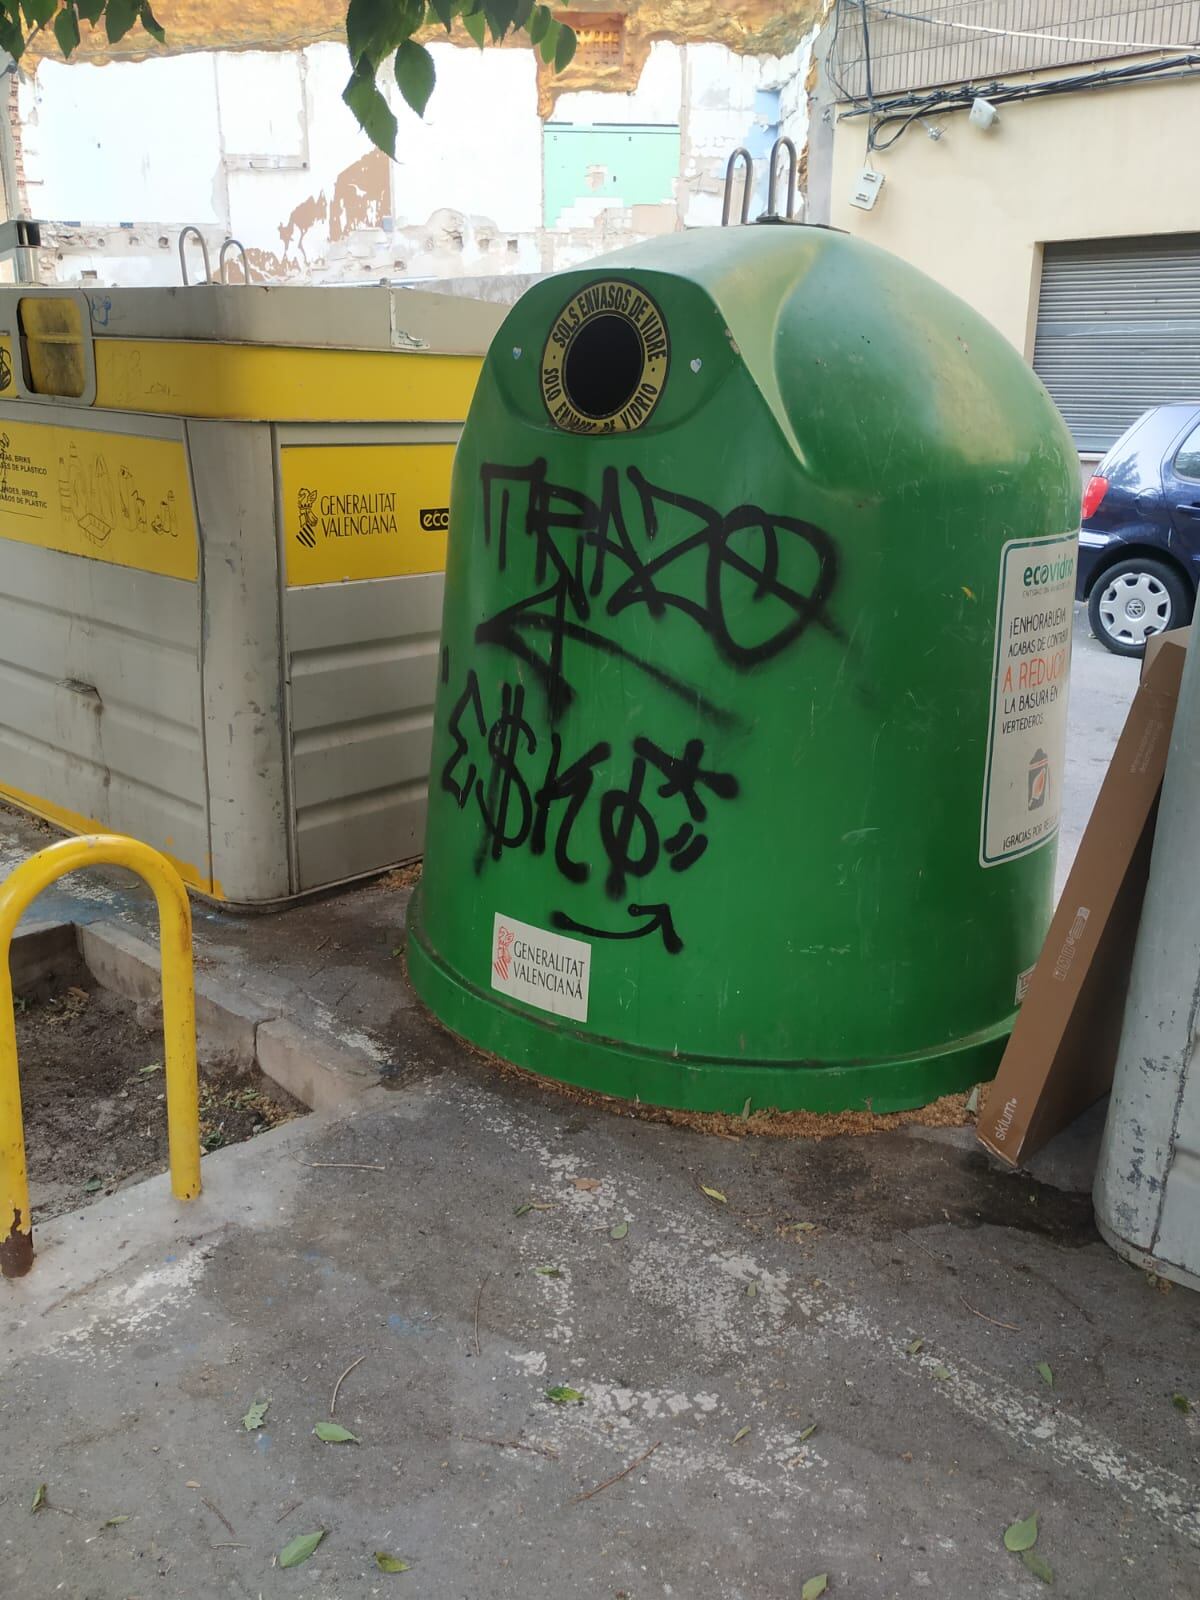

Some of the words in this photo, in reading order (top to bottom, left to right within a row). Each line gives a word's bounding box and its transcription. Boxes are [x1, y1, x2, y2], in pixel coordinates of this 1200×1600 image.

[552, 308, 581, 348] SOLS
[577, 284, 632, 316] ENVASOS
[628, 296, 649, 323] DE
[639, 312, 667, 363] VIDRE
[544, 368, 562, 402] SOLO
[620, 383, 657, 431] VIDRIO
[320, 492, 397, 517] GENERALITAT
[321, 514, 398, 539] VALENCIANA
[1008, 639, 1036, 658] ACABAS
[1037, 637, 1046, 652] DE
[1003, 665, 1013, 693] A
[1004, 697, 1016, 714] LA
[1018, 688, 1049, 712] BASURA
[1050, 686, 1059, 702] EN
[513, 940, 585, 978] GENERALITAT
[513, 961, 583, 1000] VALENCIANA
[994, 1102, 1017, 1141] sklum
